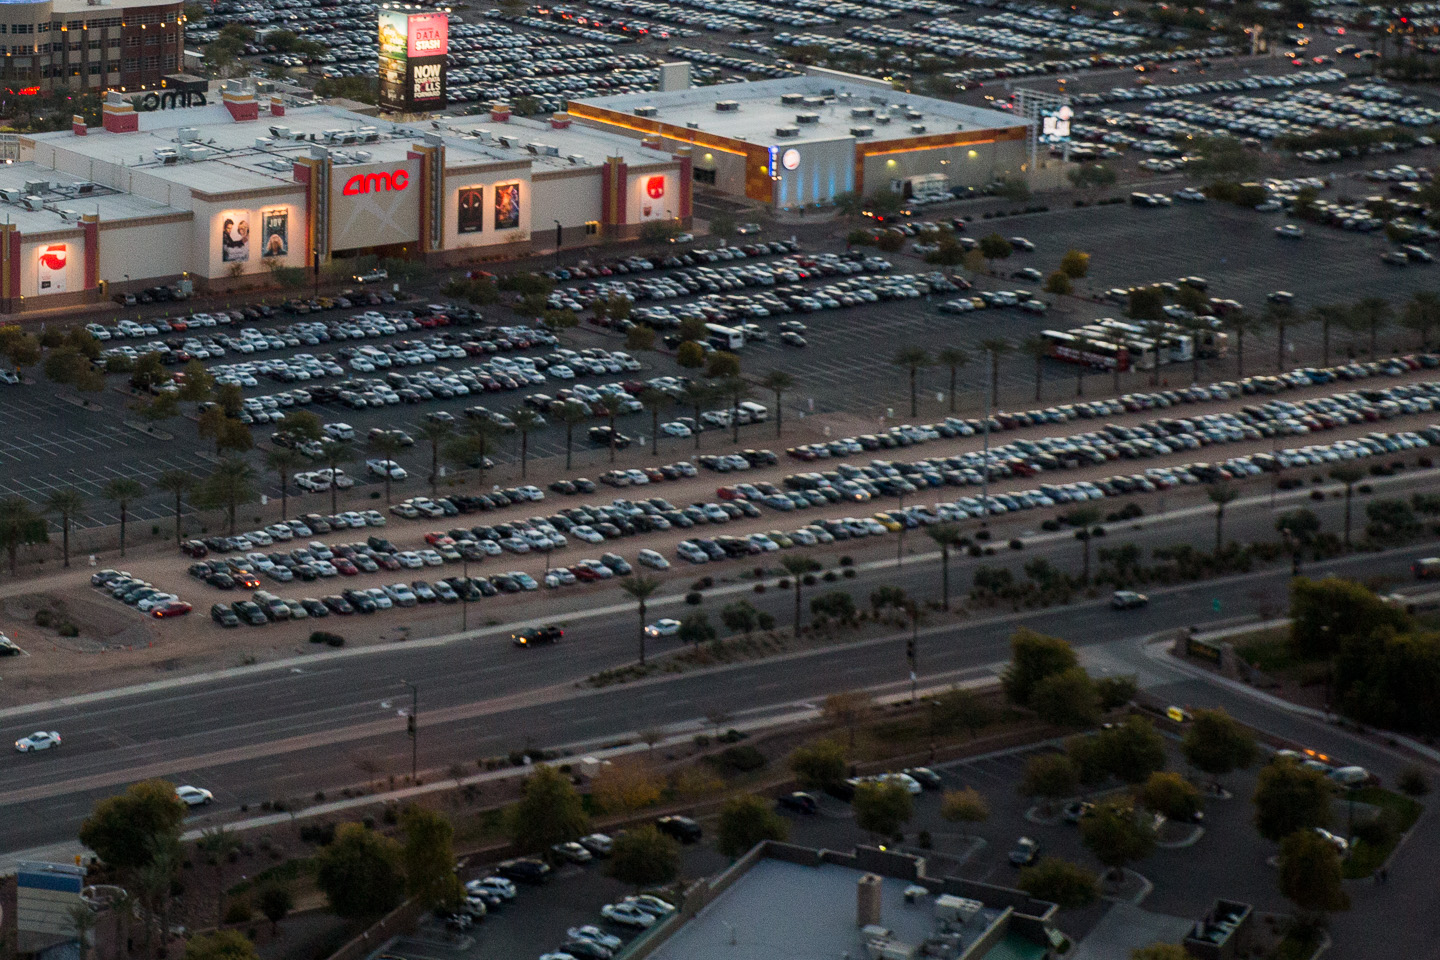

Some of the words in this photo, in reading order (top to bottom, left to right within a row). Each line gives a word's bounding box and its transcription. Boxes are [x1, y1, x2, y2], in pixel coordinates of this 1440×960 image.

[416, 30, 440, 40] DATA
[415, 40, 441, 51] STASH
[414, 64, 441, 79] NOW
[414, 82, 441, 93] ROLLS
[343, 169, 409, 196] amc
